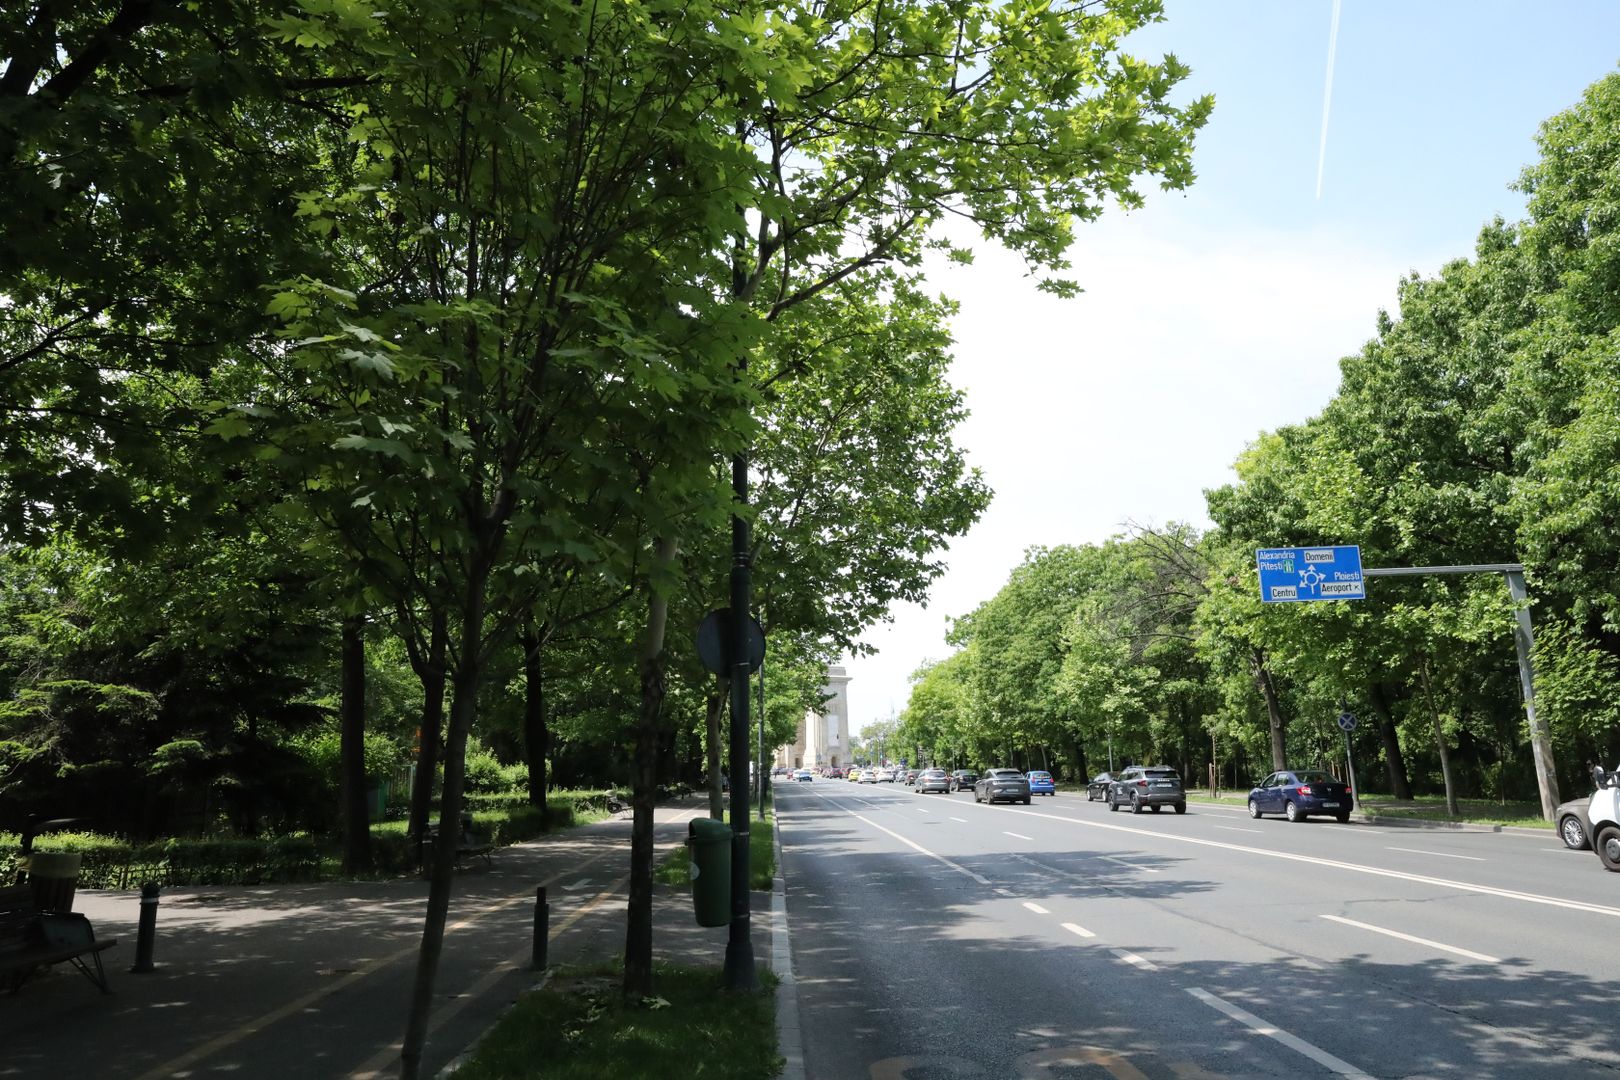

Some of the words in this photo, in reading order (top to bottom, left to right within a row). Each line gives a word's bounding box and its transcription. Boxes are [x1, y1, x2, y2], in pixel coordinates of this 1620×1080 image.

[1259, 551, 1296, 560] Alexandria
[1305, 552, 1333, 561] Domenii
[1272, 588, 1296, 597] Centru
[1321, 583, 1352, 593] Aeroport
